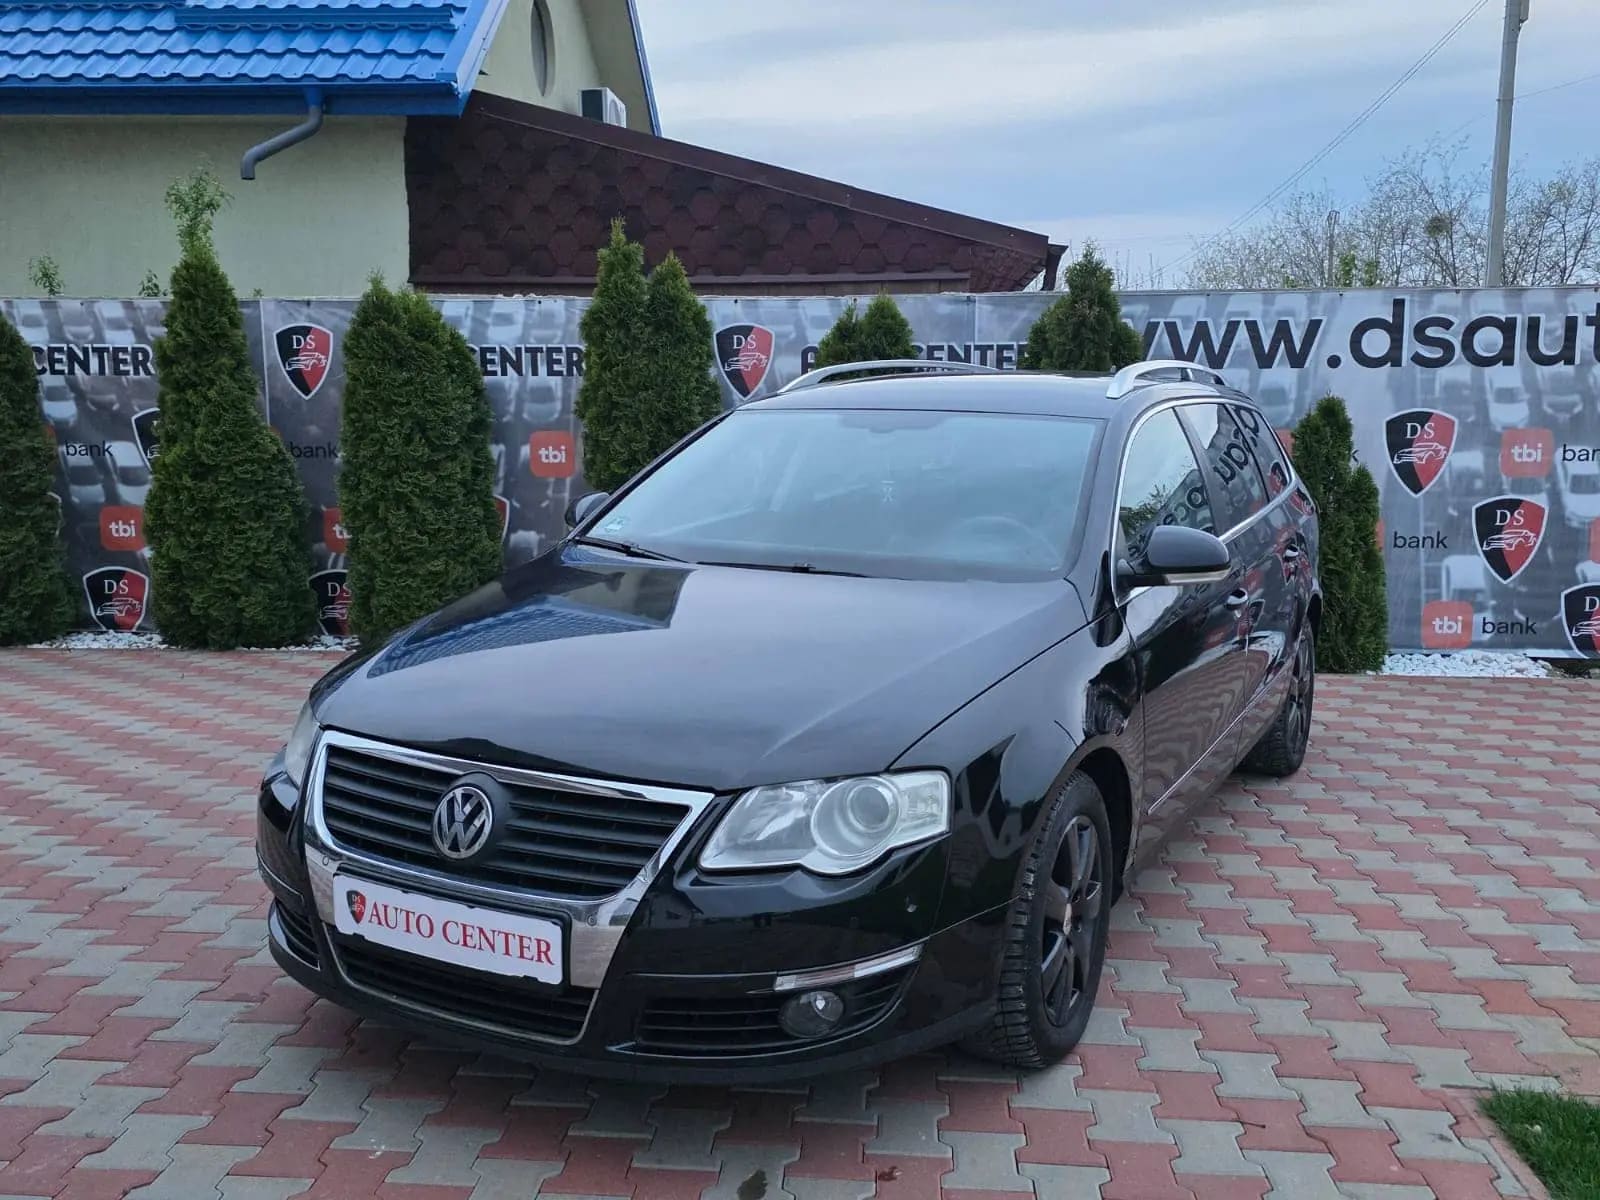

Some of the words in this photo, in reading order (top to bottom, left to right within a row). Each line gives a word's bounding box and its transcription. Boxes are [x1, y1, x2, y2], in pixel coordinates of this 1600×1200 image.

[292, 334, 316, 350] DS
[733, 333, 757, 350] DS
[472, 346, 584, 377] ENTER
[1406, 422, 1435, 439] DS
[65, 441, 114, 458] bank
[289, 441, 339, 459] bank
[538, 446, 567, 464] tbi
[1511, 443, 1543, 463] tbi
[1495, 509, 1525, 526] DS
[109, 519, 137, 538] tbi
[1392, 531, 1448, 549] bank
[104, 579, 129, 594] DS
[1432, 615, 1463, 634] tbi
[1481, 618, 1537, 635] bank
[368, 901, 434, 938] AUTO
[442, 920, 555, 965] CENTER
